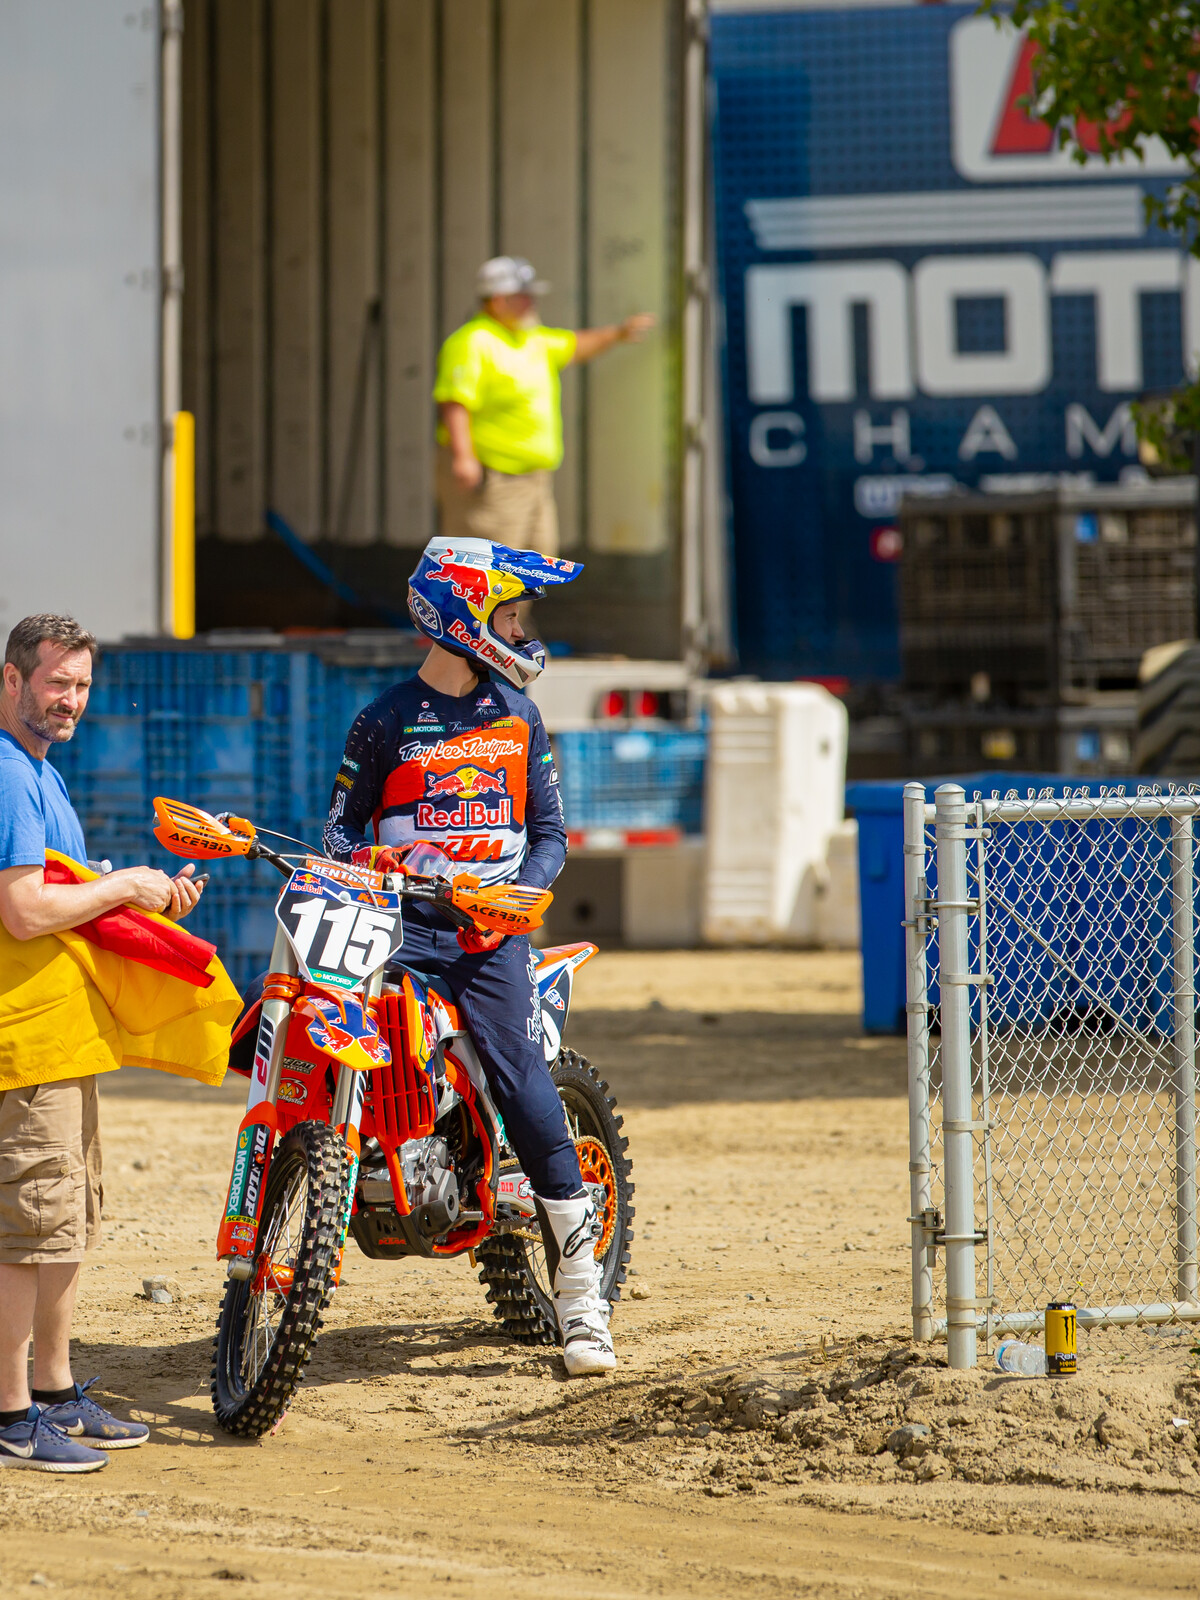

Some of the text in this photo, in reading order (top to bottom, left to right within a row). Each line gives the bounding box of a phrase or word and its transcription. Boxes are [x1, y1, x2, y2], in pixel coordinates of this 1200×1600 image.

[745, 250, 1200, 403] MOT
[447, 619, 516, 670] Red Bull
[413, 725, 444, 733] MOTOREX
[400, 737, 523, 767] Troy Lee Designs
[418, 799, 511, 827] Red Bull
[168, 832, 232, 853] ACERBIS
[437, 834, 504, 862] KTM
[311, 864, 380, 887] RENTHAL
[290, 882, 323, 895] Red Bull
[357, 892, 389, 907] KTM
[466, 903, 531, 924] ACERBIS
[290, 897, 397, 978] 115
[571, 949, 591, 964] DUNLOP
[322, 973, 352, 986] MOTOREX
[228, 1150, 247, 1214] MOTOREX
[245, 1127, 267, 1217] DULOP
